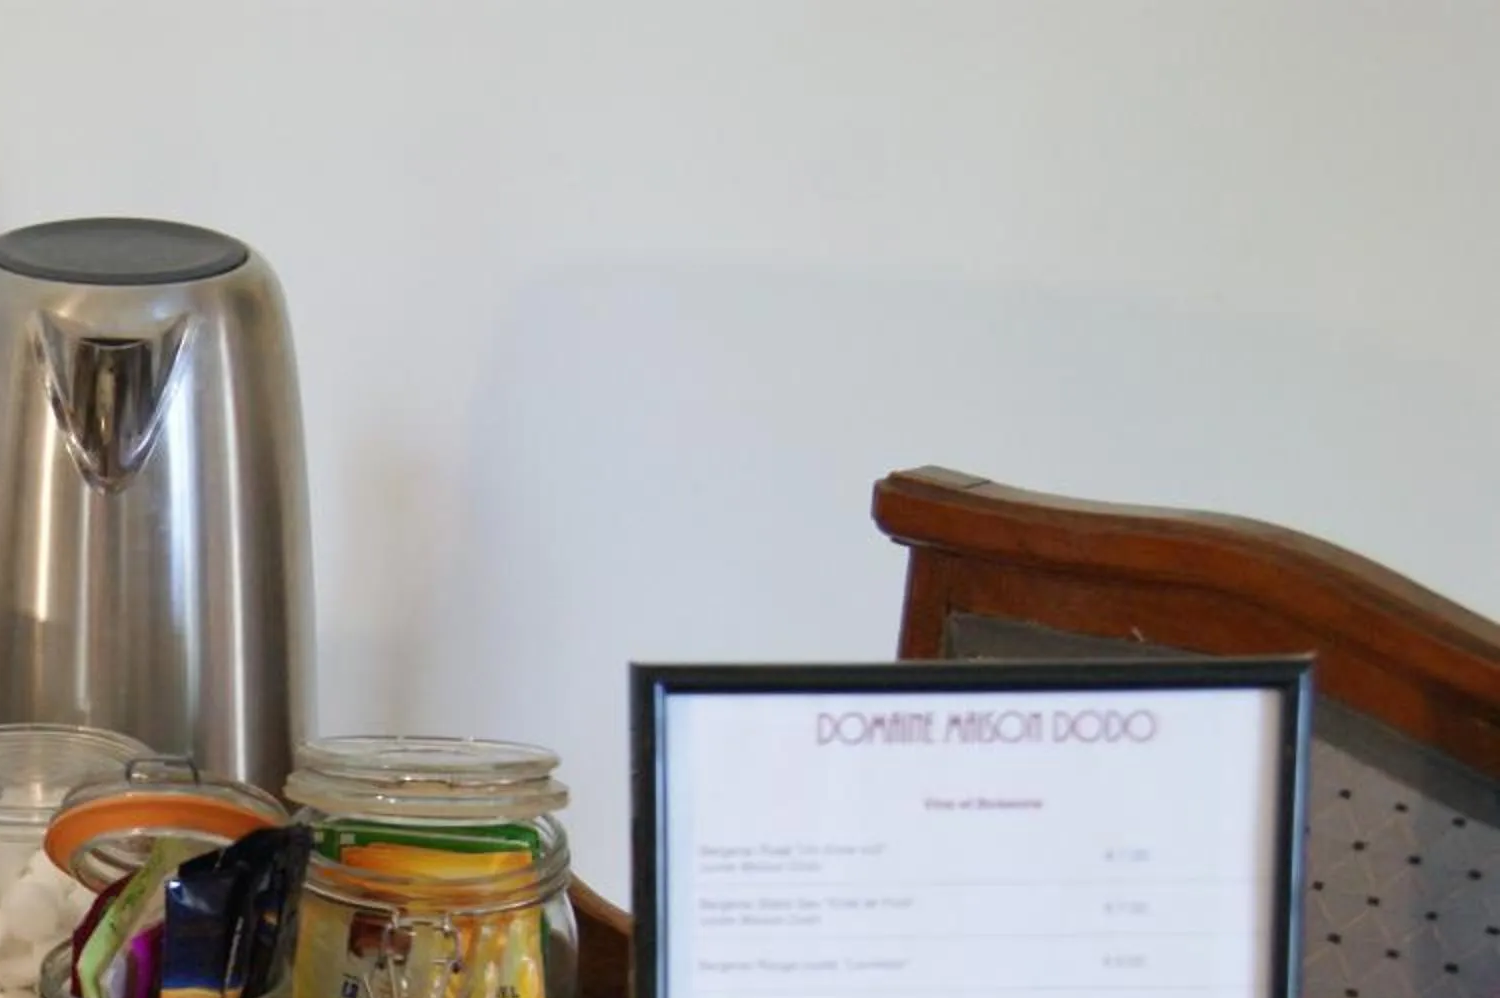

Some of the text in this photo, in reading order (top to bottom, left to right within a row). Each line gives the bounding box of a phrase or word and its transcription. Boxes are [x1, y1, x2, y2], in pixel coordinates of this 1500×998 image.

[816, 709, 1158, 747] DOMAINE MAISON DODO
